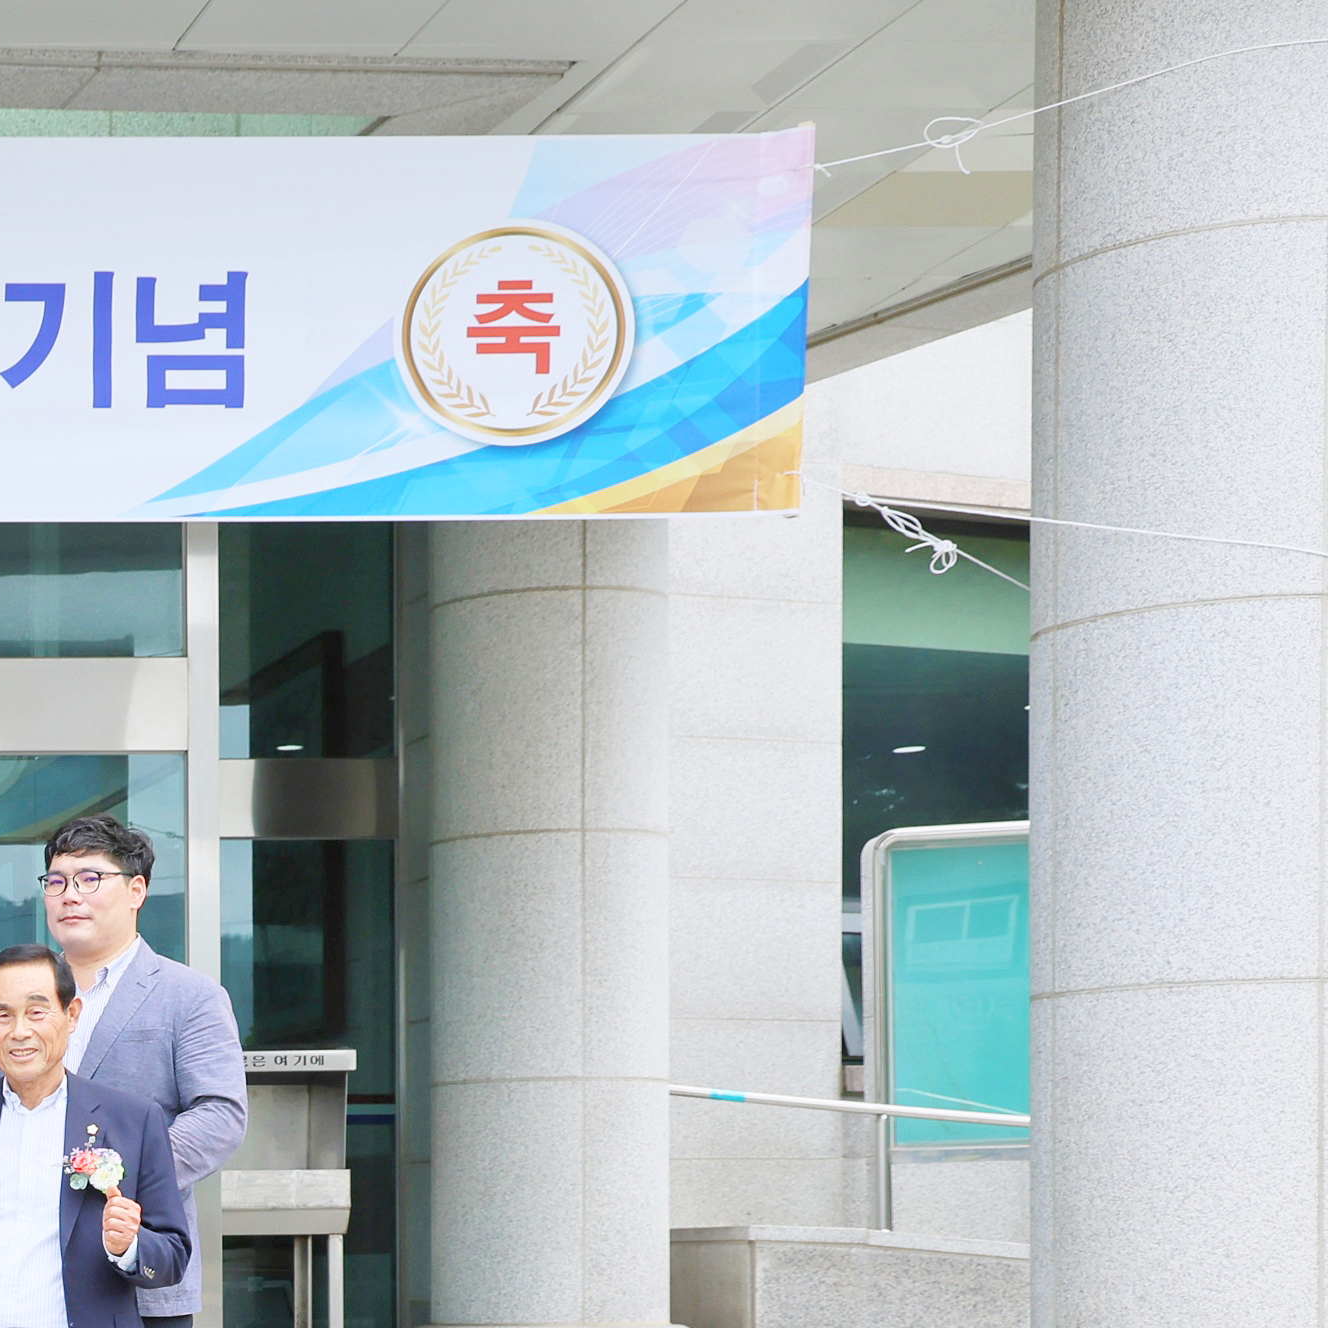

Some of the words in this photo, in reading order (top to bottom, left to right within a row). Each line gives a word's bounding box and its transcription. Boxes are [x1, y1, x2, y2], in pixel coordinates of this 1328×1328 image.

[0, 271, 248, 408] 기념
[467, 281, 562, 375] 축
[274, 1055, 324, 1066] 여기에
